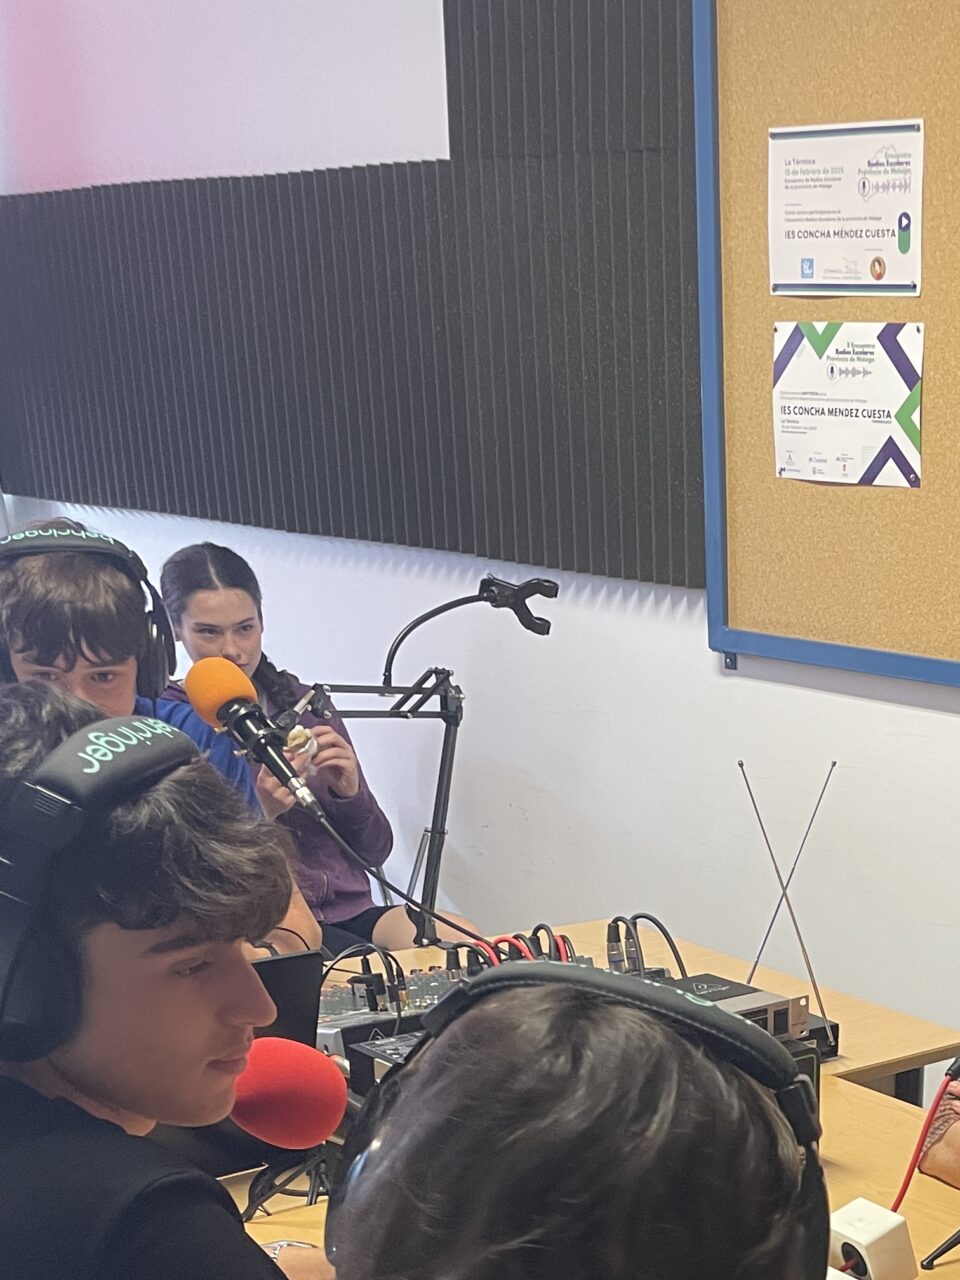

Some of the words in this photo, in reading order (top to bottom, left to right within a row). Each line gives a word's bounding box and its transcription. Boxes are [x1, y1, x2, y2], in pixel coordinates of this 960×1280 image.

[784, 230, 795, 239] IES
[797, 229, 831, 239] CONCHA
[833, 227, 863, 238] MÉNDEZ
[865, 229, 896, 238] CUESTA
[780, 405, 791, 415] IES
[793, 406, 826, 417] CONCHA
[861, 408, 892, 419] CUESTA
